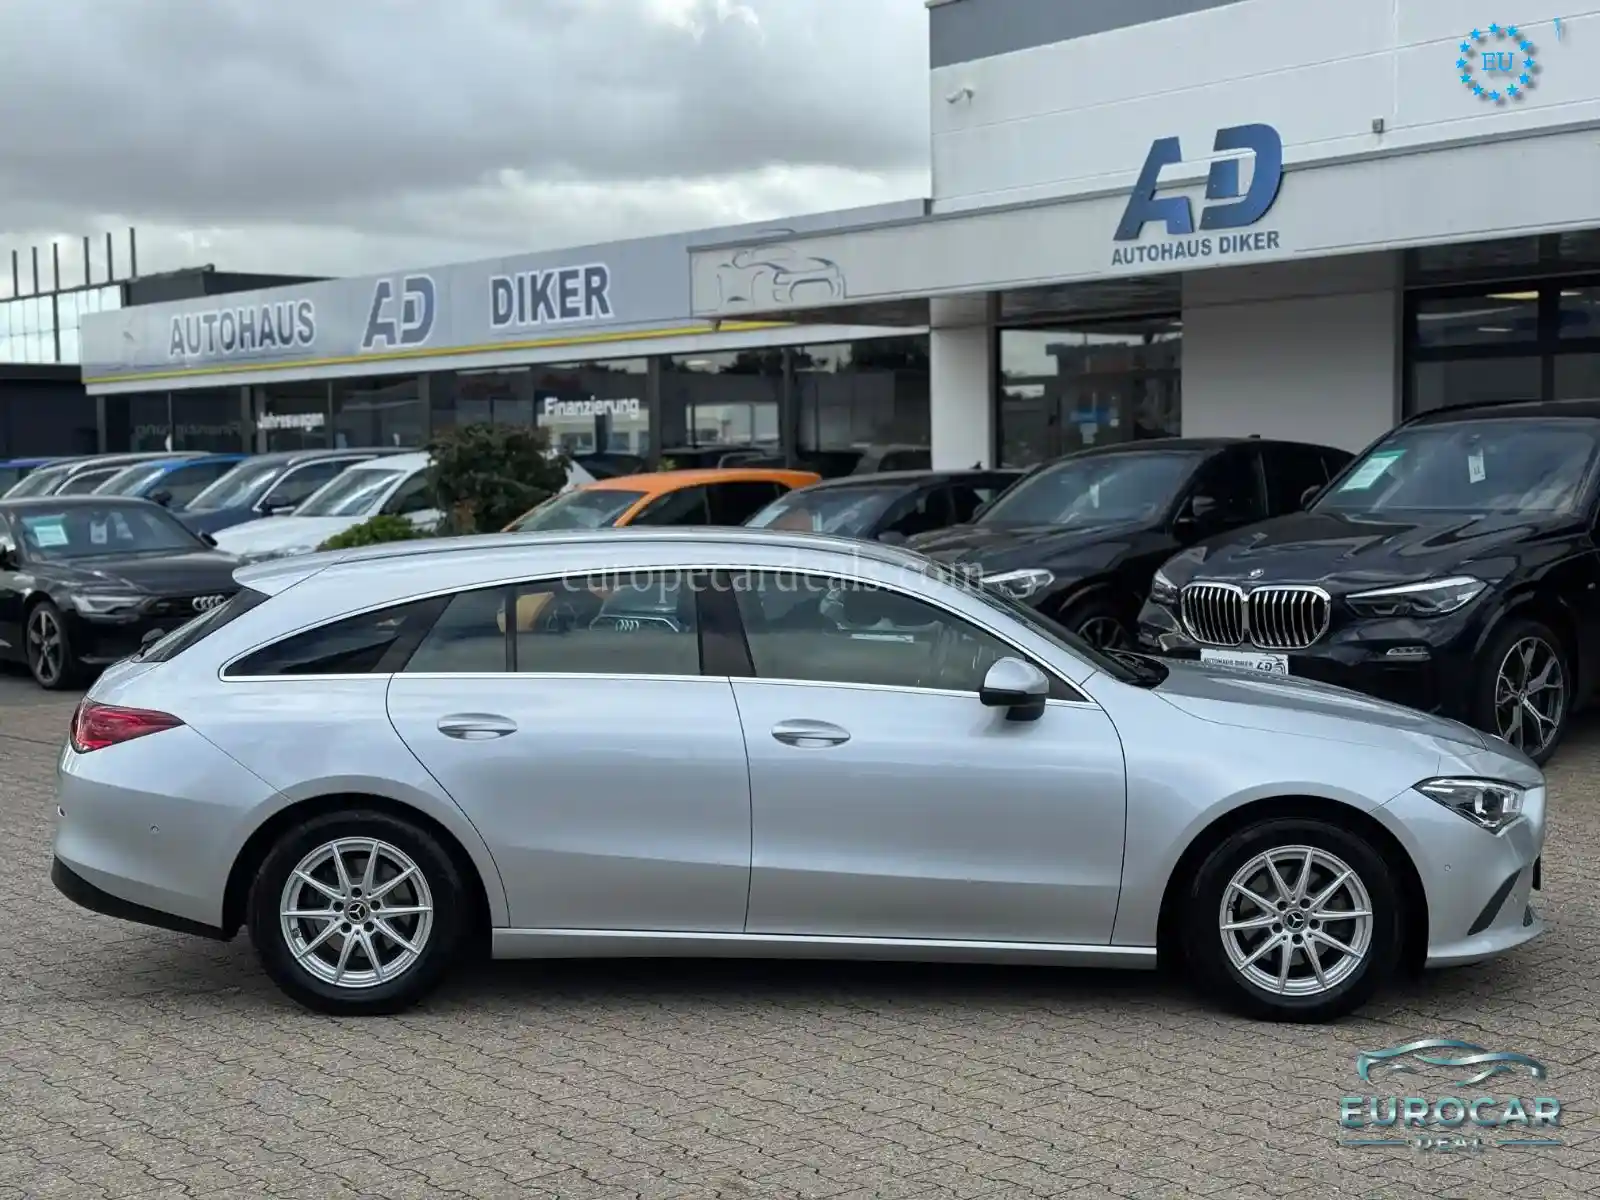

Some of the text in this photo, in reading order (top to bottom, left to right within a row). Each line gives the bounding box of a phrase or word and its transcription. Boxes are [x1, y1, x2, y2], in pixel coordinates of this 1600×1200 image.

[1113, 123, 1283, 241] AD
[1111, 230, 1280, 267] AUTOHAUS DIKER
[169, 264, 613, 357] AUTOHAUS AD DIKER
[544, 396, 640, 420] Finanzierung
